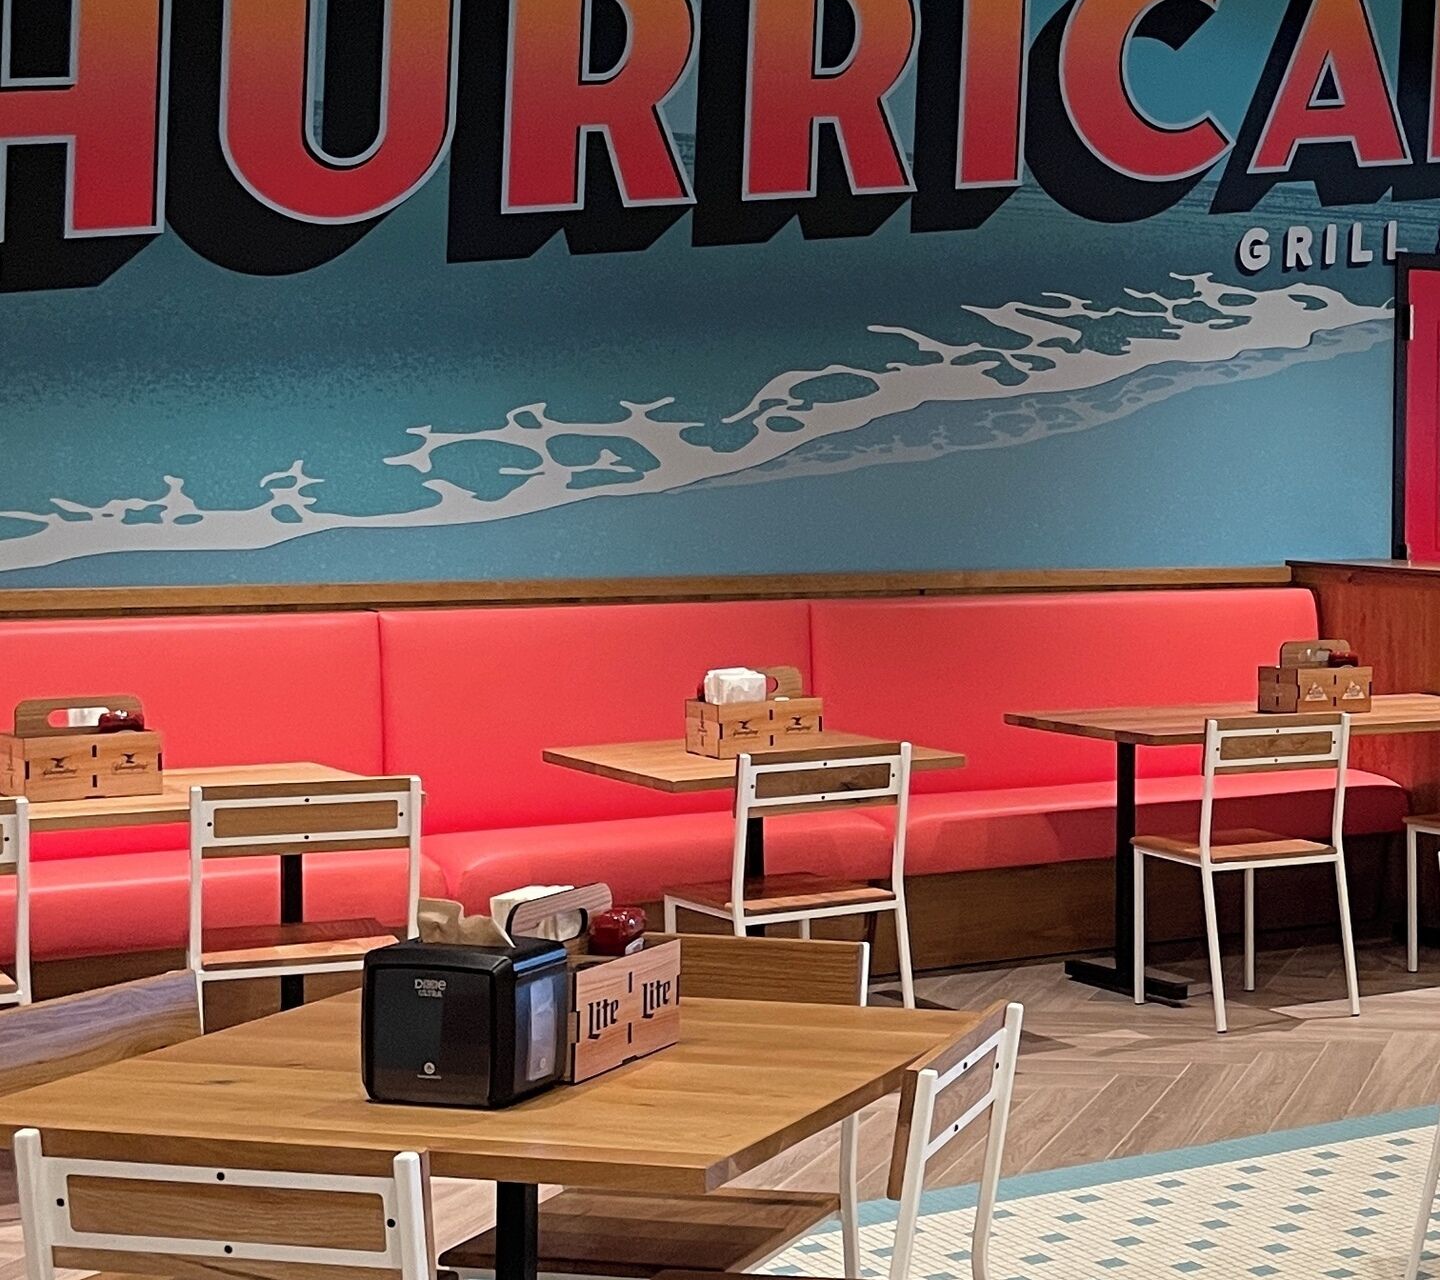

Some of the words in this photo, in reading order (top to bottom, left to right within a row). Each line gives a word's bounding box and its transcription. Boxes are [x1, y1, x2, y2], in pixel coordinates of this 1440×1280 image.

[1239, 221, 1408, 271] GRILL
[588, 998, 619, 1040] Lite
[641, 979, 671, 1019] Lite
